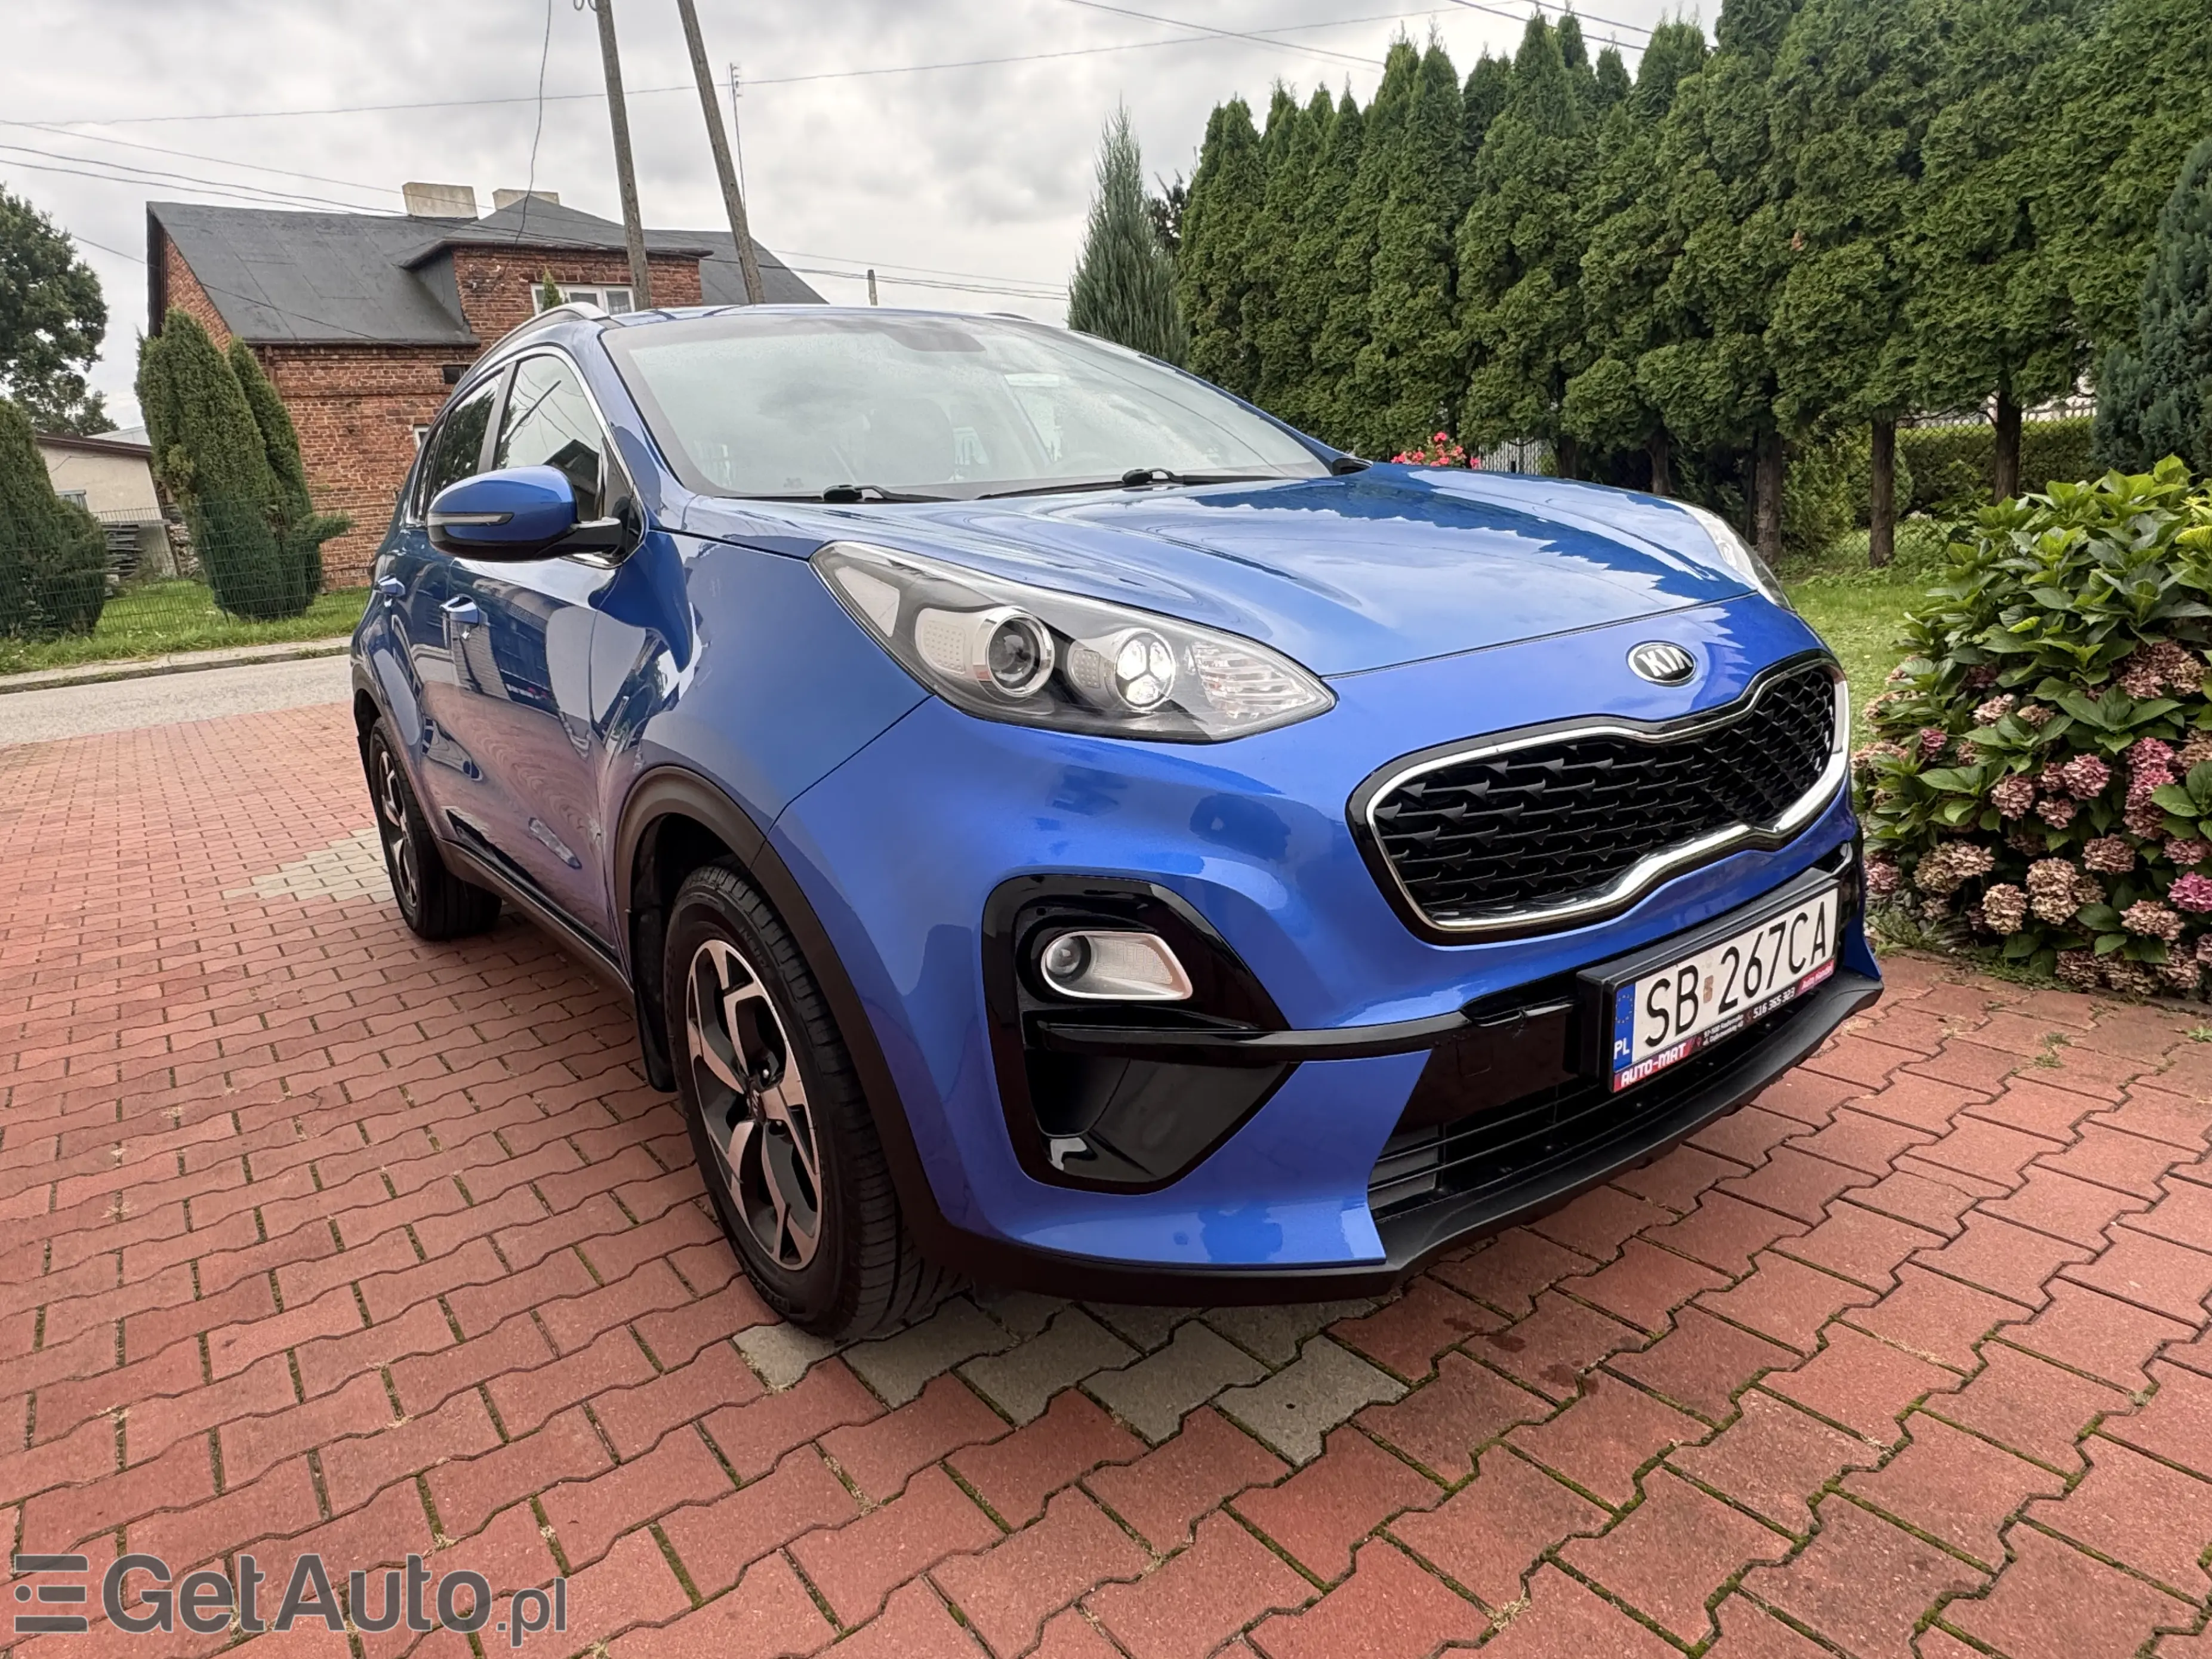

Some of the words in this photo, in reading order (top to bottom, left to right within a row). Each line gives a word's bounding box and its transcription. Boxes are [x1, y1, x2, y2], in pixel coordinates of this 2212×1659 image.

[1636, 646, 1693, 677] KIA
[1645, 964, 1699, 1047] SB
[1718, 901, 1826, 1015] 267CA
[1613, 1037, 1630, 1060] PL
[1621, 1042, 1687, 1088] AUTO-MAT
